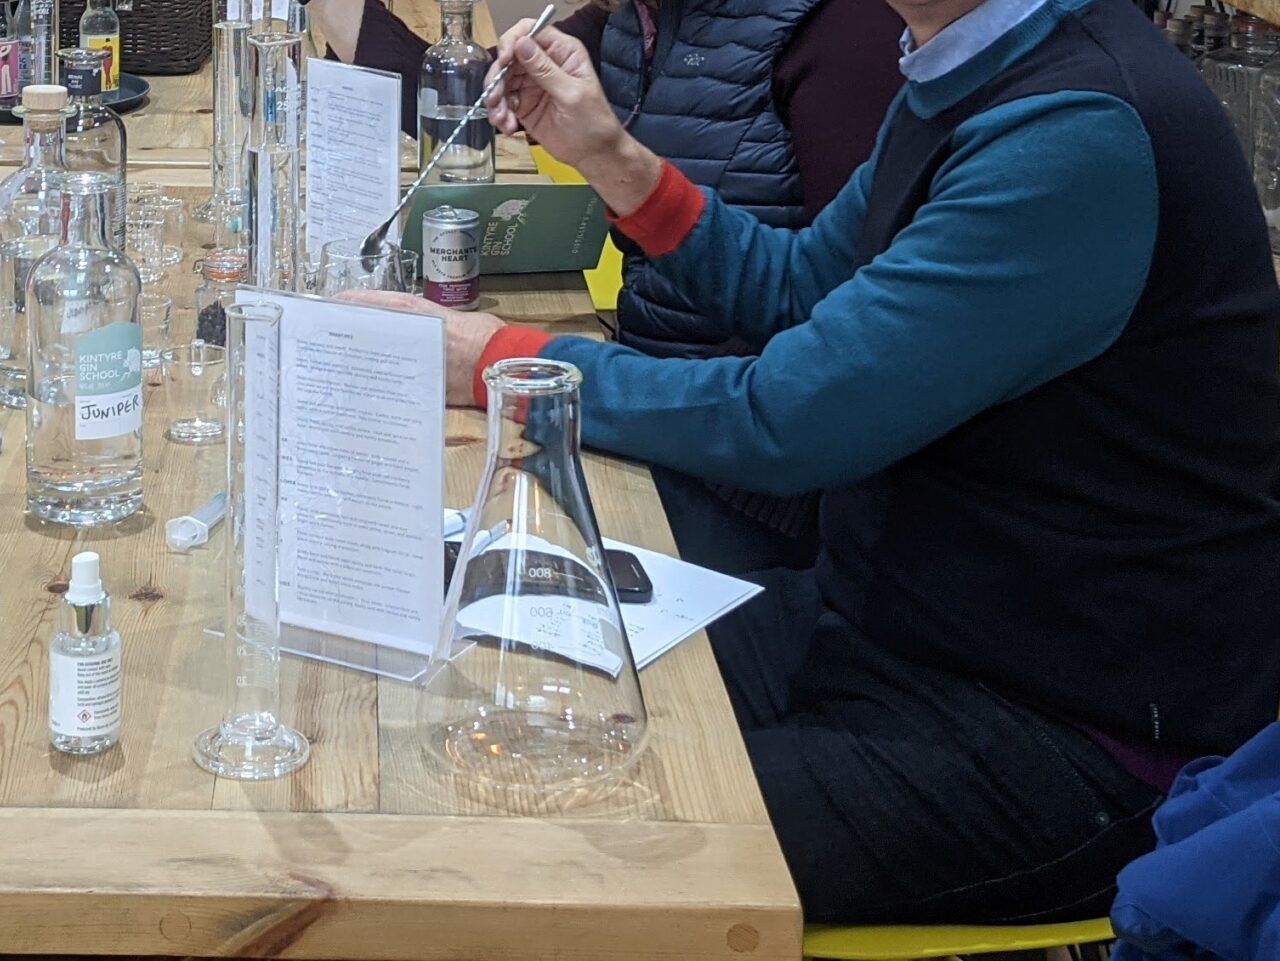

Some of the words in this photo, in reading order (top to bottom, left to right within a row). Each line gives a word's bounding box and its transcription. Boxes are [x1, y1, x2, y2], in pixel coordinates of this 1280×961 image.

[480, 221, 498, 256] KINTYRE
[500, 223, 518, 256] SCHOOL
[490, 241, 503, 256] GIN
[442, 254, 468, 262] HEART
[80, 350, 123, 363] KINTYRE
[80, 363, 98, 372] GIN
[80, 370, 120, 381] SCHOOL
[81, 394, 139, 420] JUNIPER
